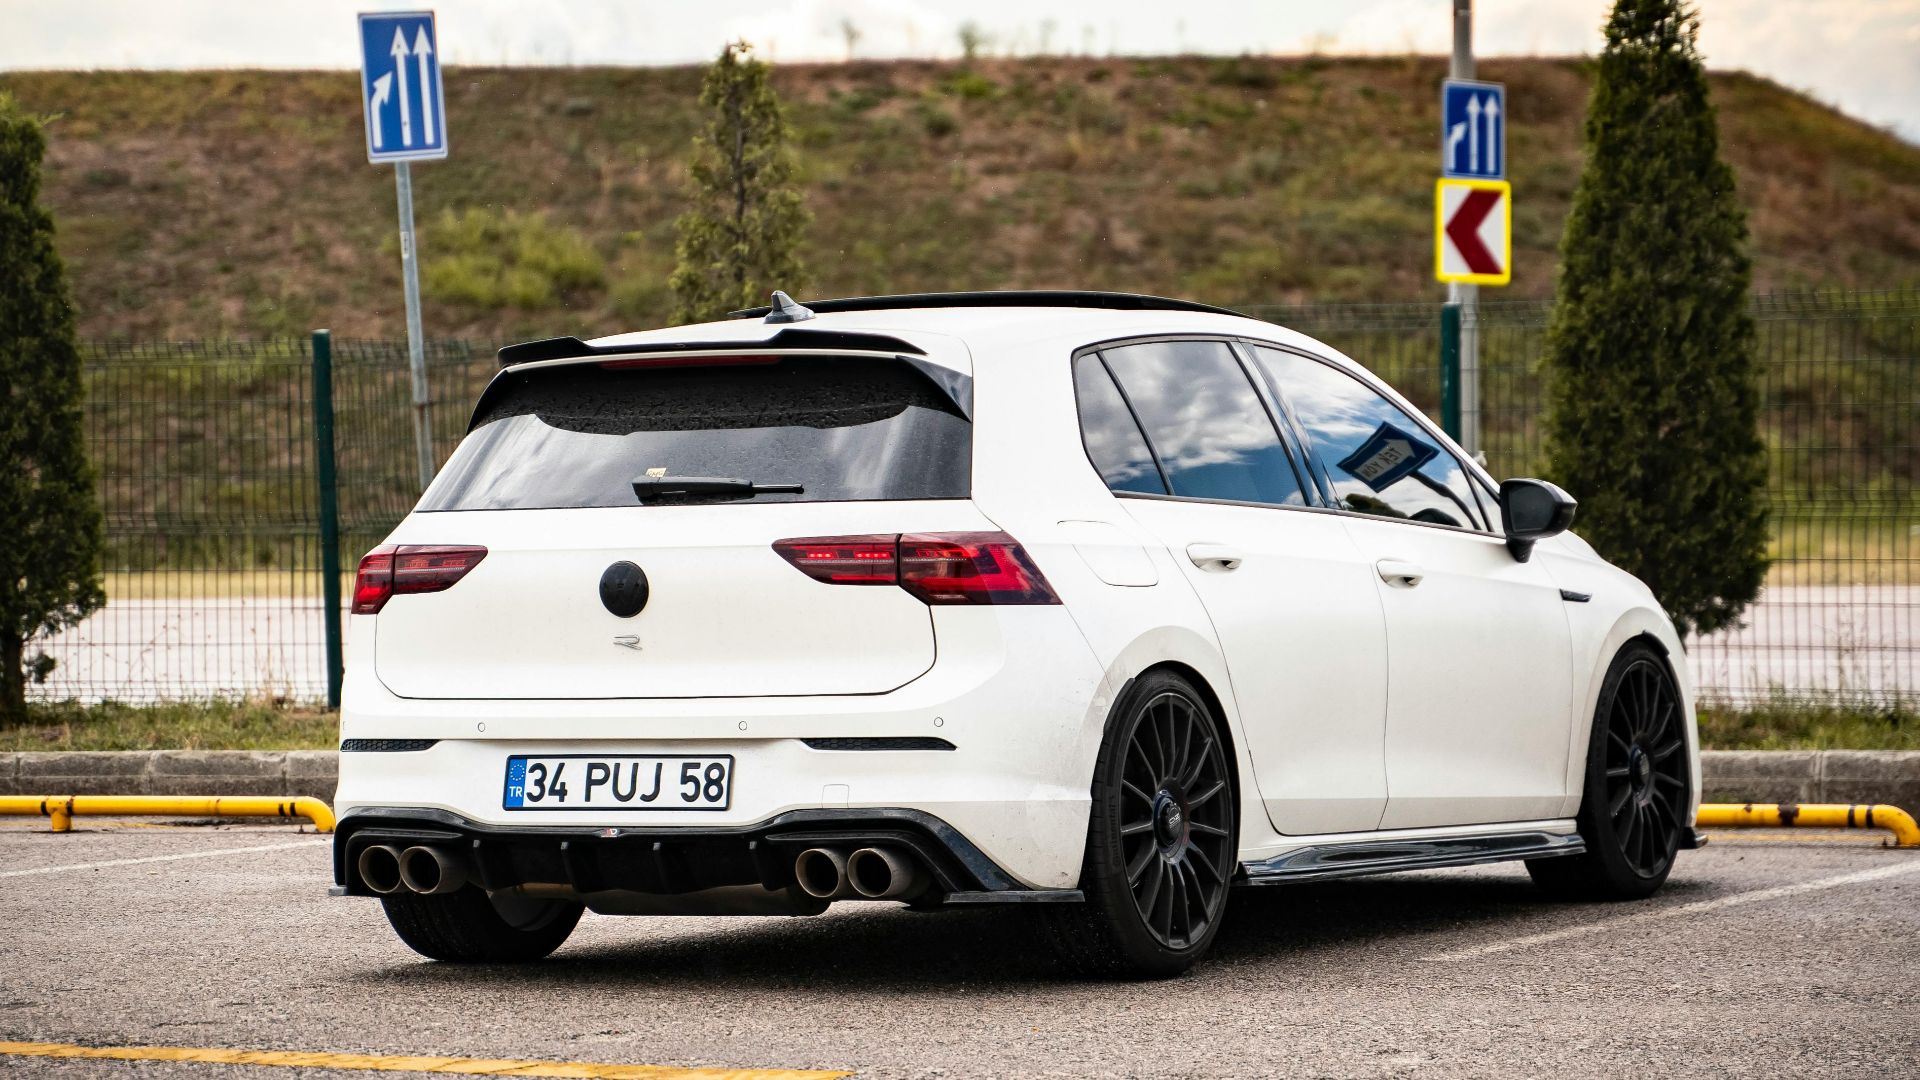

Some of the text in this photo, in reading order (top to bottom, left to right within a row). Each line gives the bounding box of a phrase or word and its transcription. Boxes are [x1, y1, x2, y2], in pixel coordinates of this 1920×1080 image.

[509, 786, 523, 798] TR
[526, 762, 726, 802] 34 PUJ 58
